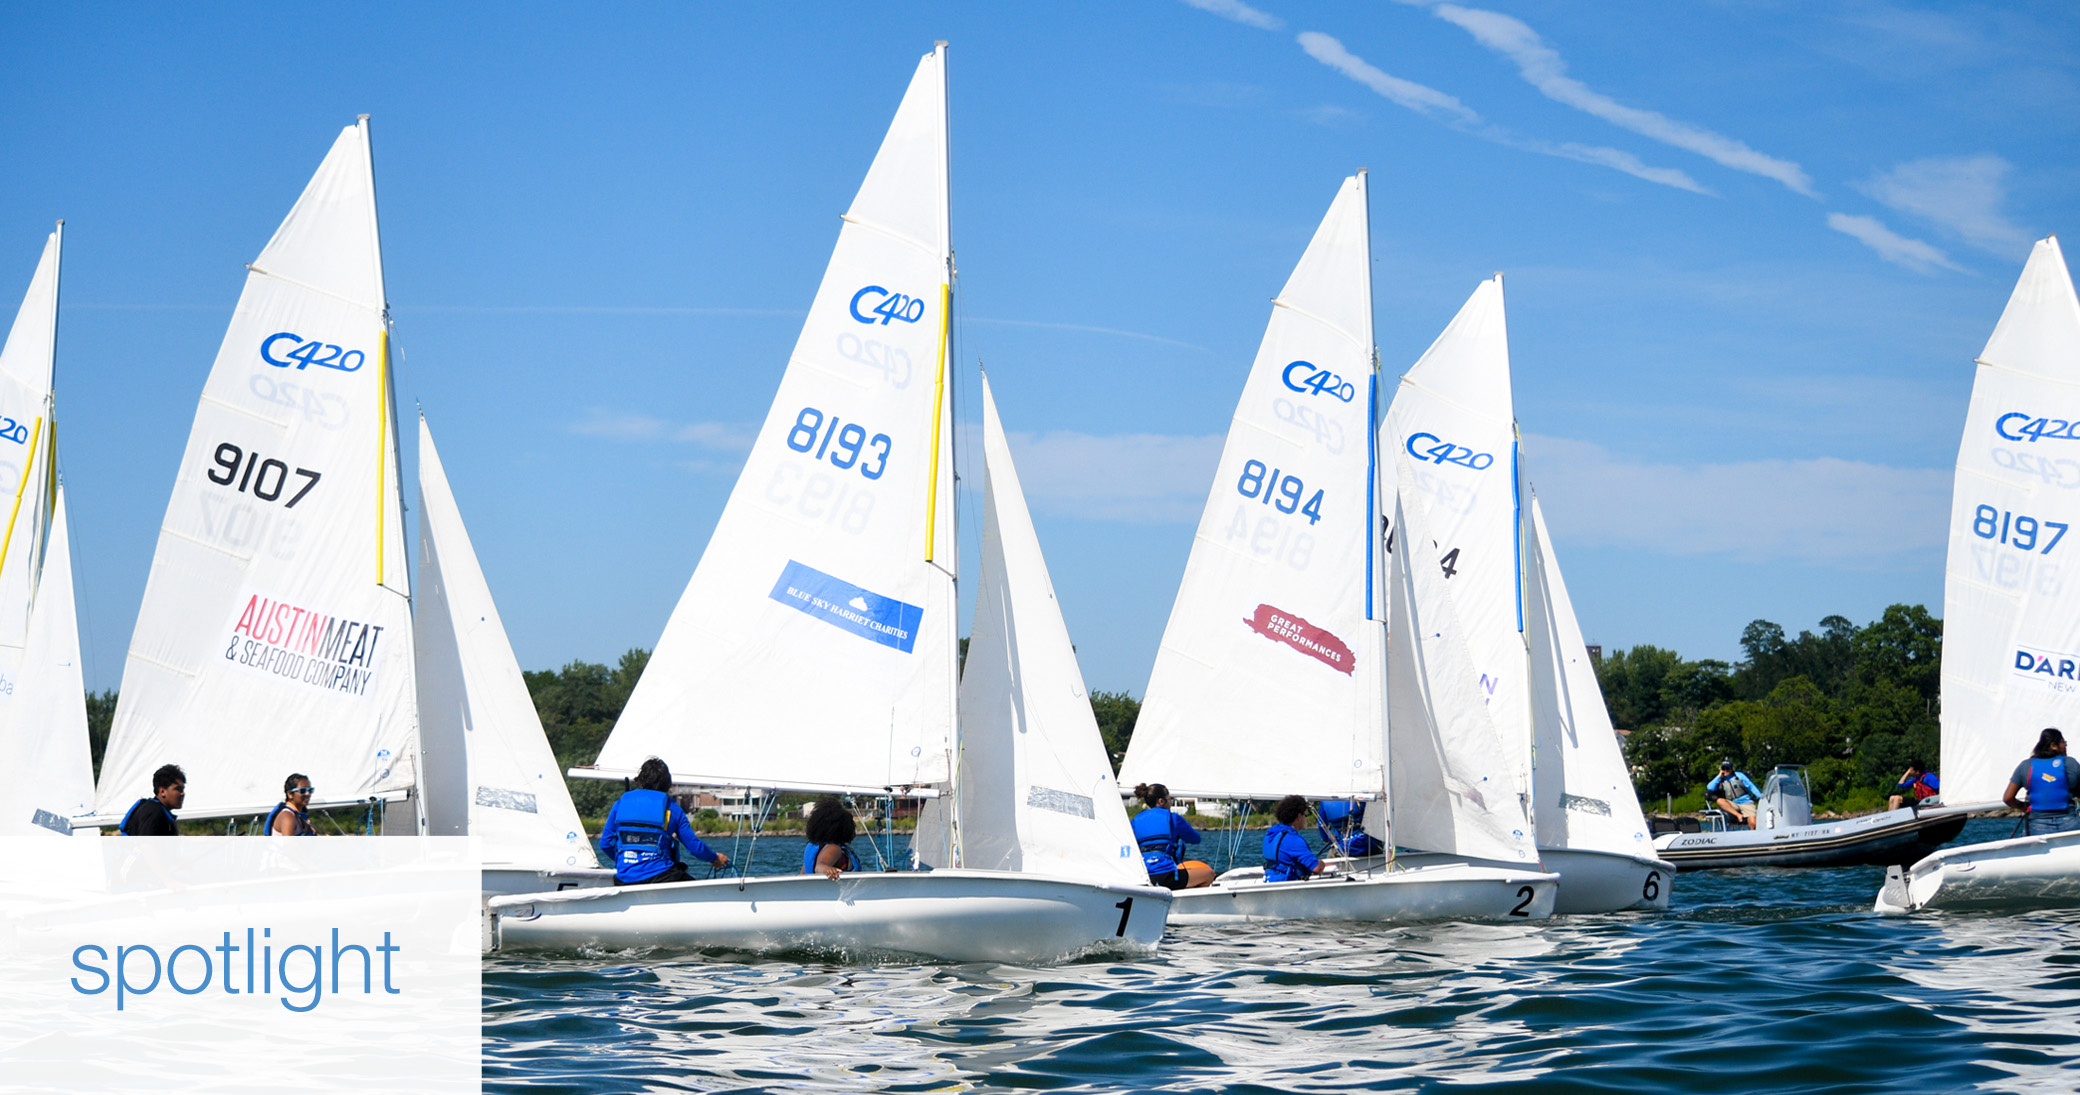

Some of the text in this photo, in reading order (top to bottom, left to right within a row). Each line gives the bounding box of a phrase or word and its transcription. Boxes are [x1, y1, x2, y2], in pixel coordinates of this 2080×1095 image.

[849, 285, 925, 325] C420
[261, 332, 365, 372] C420
[1281, 360, 1355, 403] C420
[787, 407, 892, 480] 8193
[1406, 432, 1494, 470] C420
[207, 442, 322, 509] 9107
[1237, 459, 1325, 526] 8194
[1973, 504, 2068, 554] 8197
[787, 586, 908, 640] BLUE SKY HARRIET CHARITIES
[1270, 614, 1303, 634] GREAT
[1267, 622, 1342, 662] PERFORMANCES
[225, 635, 372, 696] & SEAFOOD COMPANY
[1681, 837, 1718, 846] ZODIAC
[1509, 885, 1535, 917] 2
[1643, 871, 1661, 901] 6
[1115, 896, 1134, 938] 1
